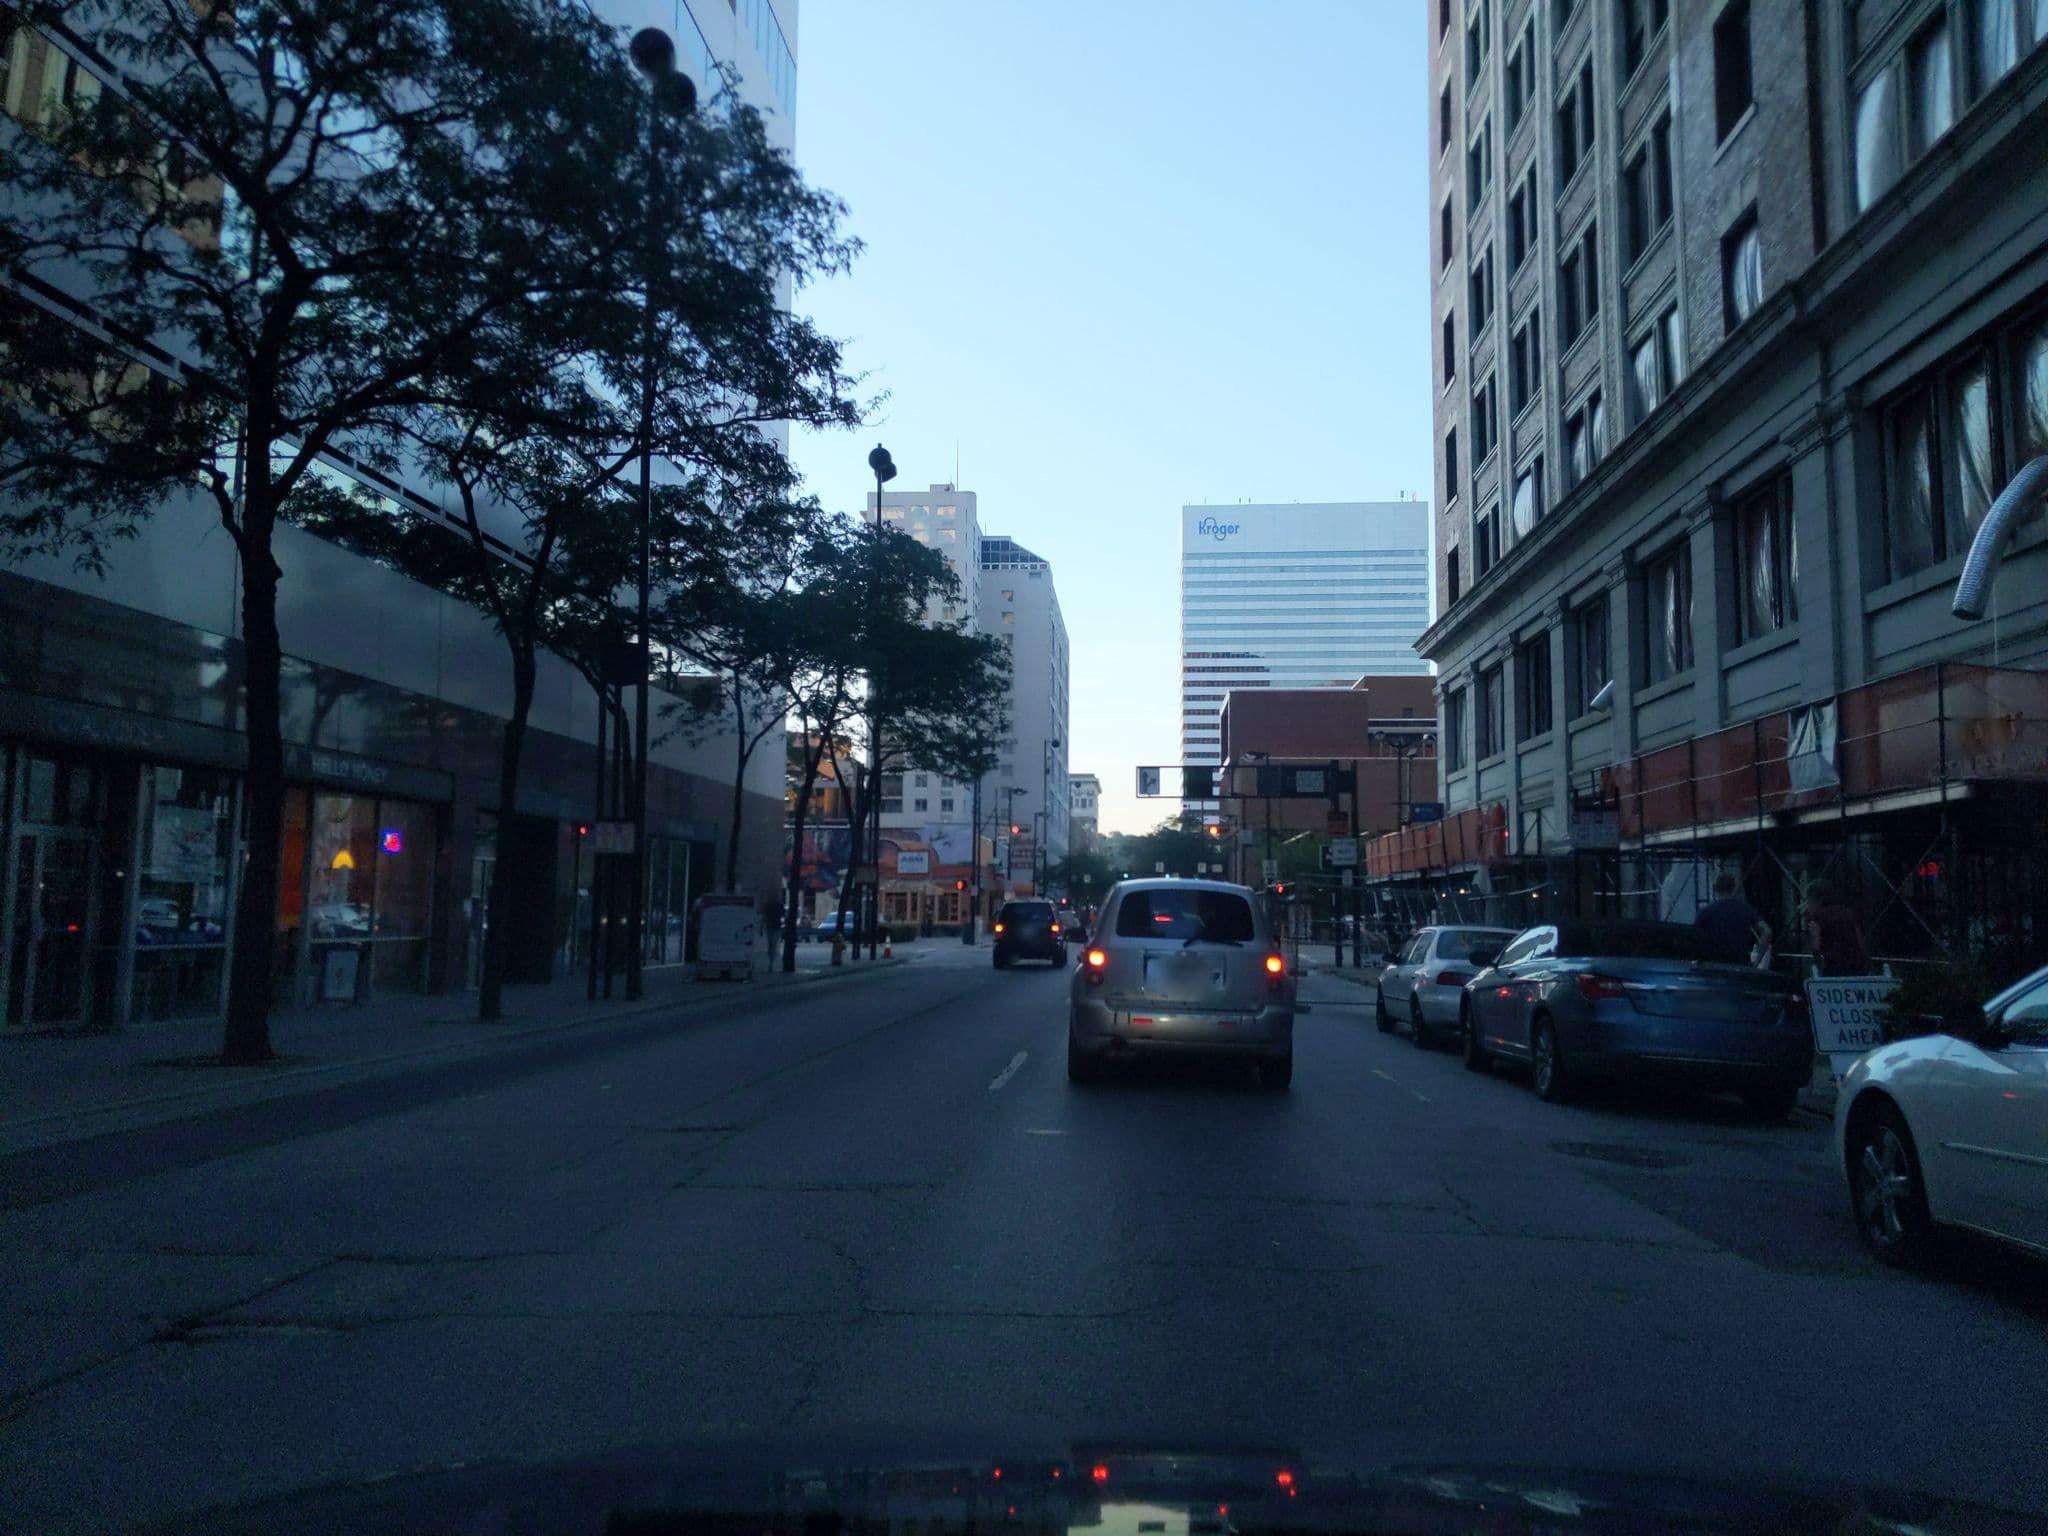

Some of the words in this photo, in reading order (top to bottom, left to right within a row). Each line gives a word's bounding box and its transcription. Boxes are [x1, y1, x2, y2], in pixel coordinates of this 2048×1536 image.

[1199, 517, 1240, 541] Kroger
[1816, 989, 1888, 1004] SIDEWAL
[1829, 1009, 1881, 1024] CLOS
